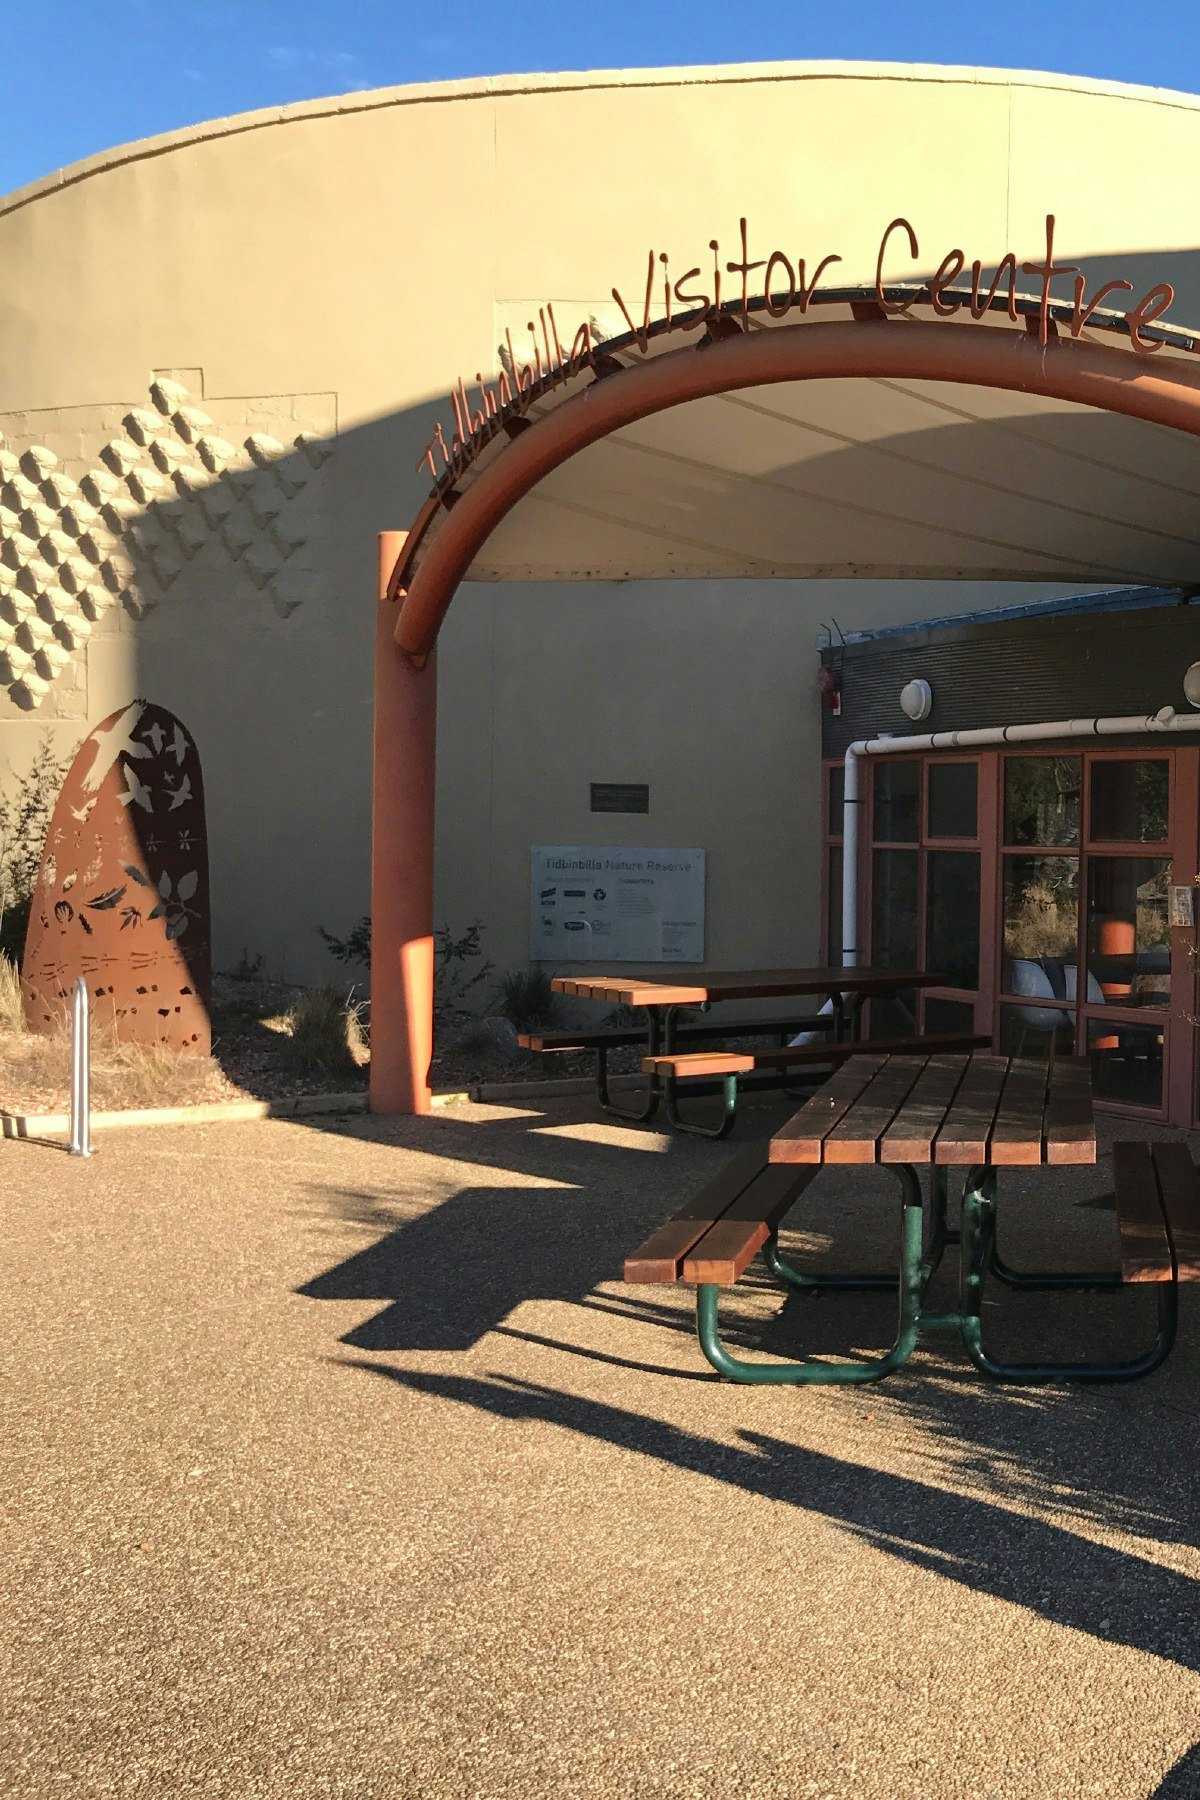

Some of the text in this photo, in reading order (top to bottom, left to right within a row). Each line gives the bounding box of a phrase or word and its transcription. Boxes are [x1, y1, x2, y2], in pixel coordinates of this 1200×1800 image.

[612, 217, 842, 354] Visitor
[876, 215, 1174, 354] Centre
[545, 858, 692, 872] Tidbinbilla Nature Reserve
